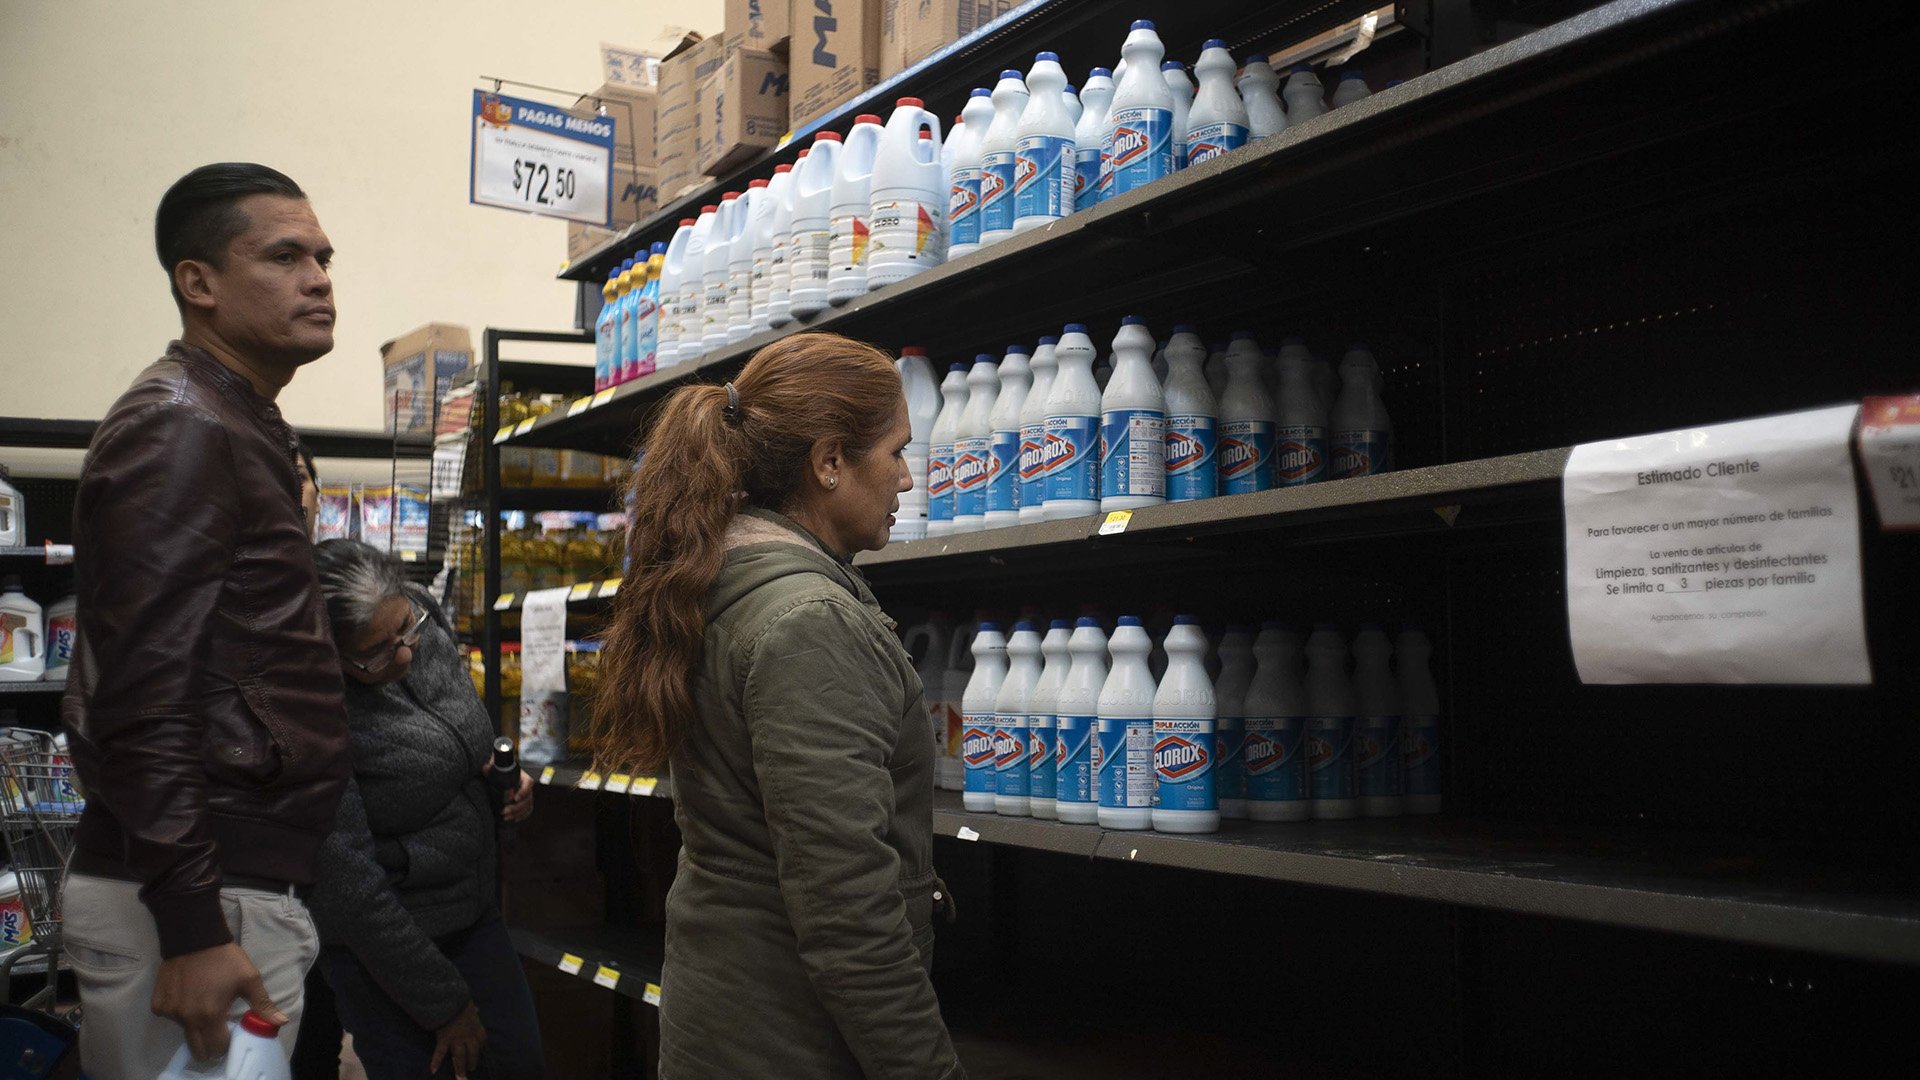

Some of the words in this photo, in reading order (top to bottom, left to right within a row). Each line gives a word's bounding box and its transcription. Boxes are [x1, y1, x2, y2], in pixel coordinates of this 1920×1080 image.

[518, 106, 564, 129] PAGAS
[565, 117, 612, 138] MENOS
[1638, 465, 1701, 485] Estimado
[1706, 459, 1760, 477] Cliente
[1587, 527, 1609, 538] Para
[1611, 522, 1660, 536] favorecer
[1662, 523, 1670, 531] a
[1671, 521, 1685, 531] un
[1687, 518, 1720, 532] mayor
[1722, 513, 1766, 527] número
[1769, 510, 1785, 523] de
[1787, 506, 1833, 521] familias
[1650, 550, 1661, 560] La
[1662, 548, 1689, 559] venta
[1691, 546, 1704, 557] de
[1748, 541, 1763, 552] de
[1596, 566, 1649, 580] Limpieza,
[1651, 560, 1720, 577] sanitizantes
[1722, 562, 1730, 574] y
[1733, 553, 1829, 572] desinfectantes
[1606, 583, 1620, 596] Se
[1622, 582, 1654, 595] limita
[1705, 577, 1745, 592] piezas
[1748, 576, 1769, 590] por
[1771, 570, 1816, 586] familia
[1173, 720, 1200, 730] ACCIÓN
[1154, 743, 1201, 770] CLOROX
[4, 911, 20, 945] MAS
